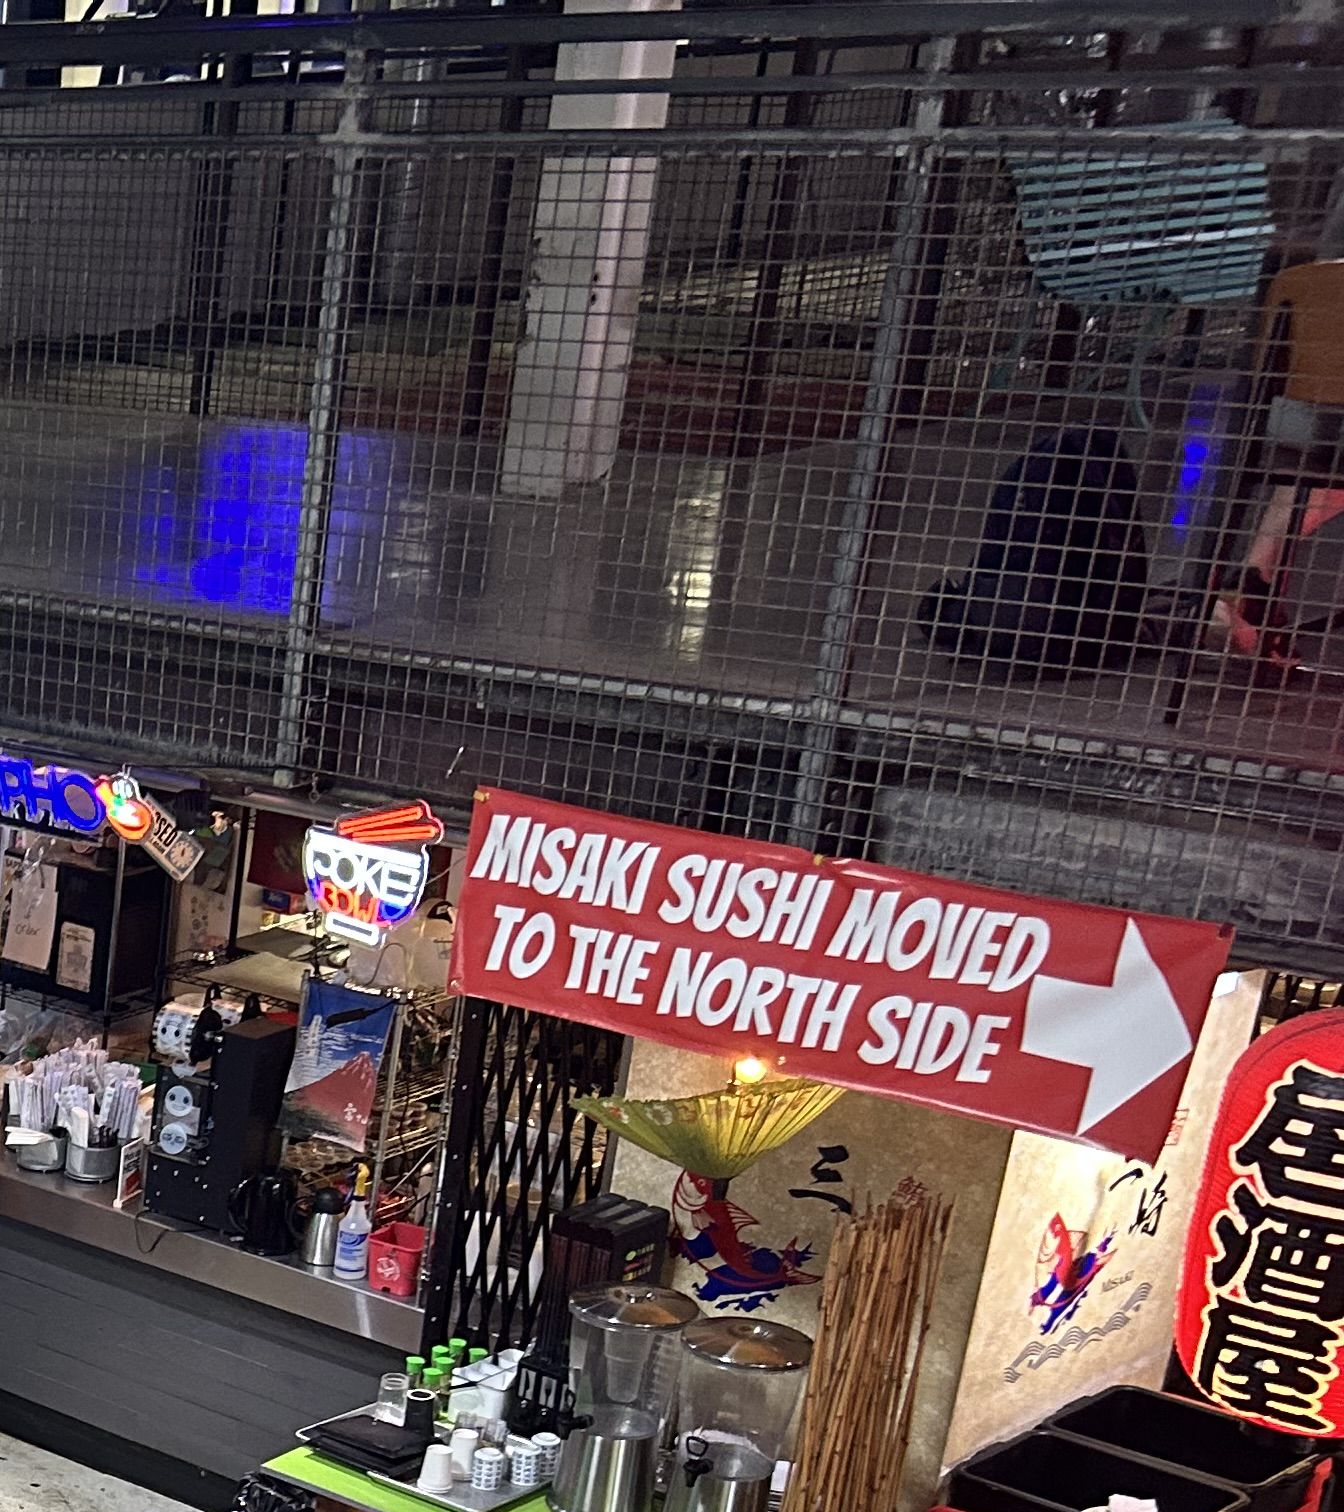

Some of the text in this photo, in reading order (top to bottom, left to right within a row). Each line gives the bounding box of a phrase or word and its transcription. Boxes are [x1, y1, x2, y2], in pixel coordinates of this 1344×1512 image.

[311, 848, 421, 908] POKE
[318, 880, 392, 928] BOWL
[469, 814, 1052, 993] MISAKI SUSHI MOVED
[484, 904, 1012, 1084] TO THE NORTH SIDE
